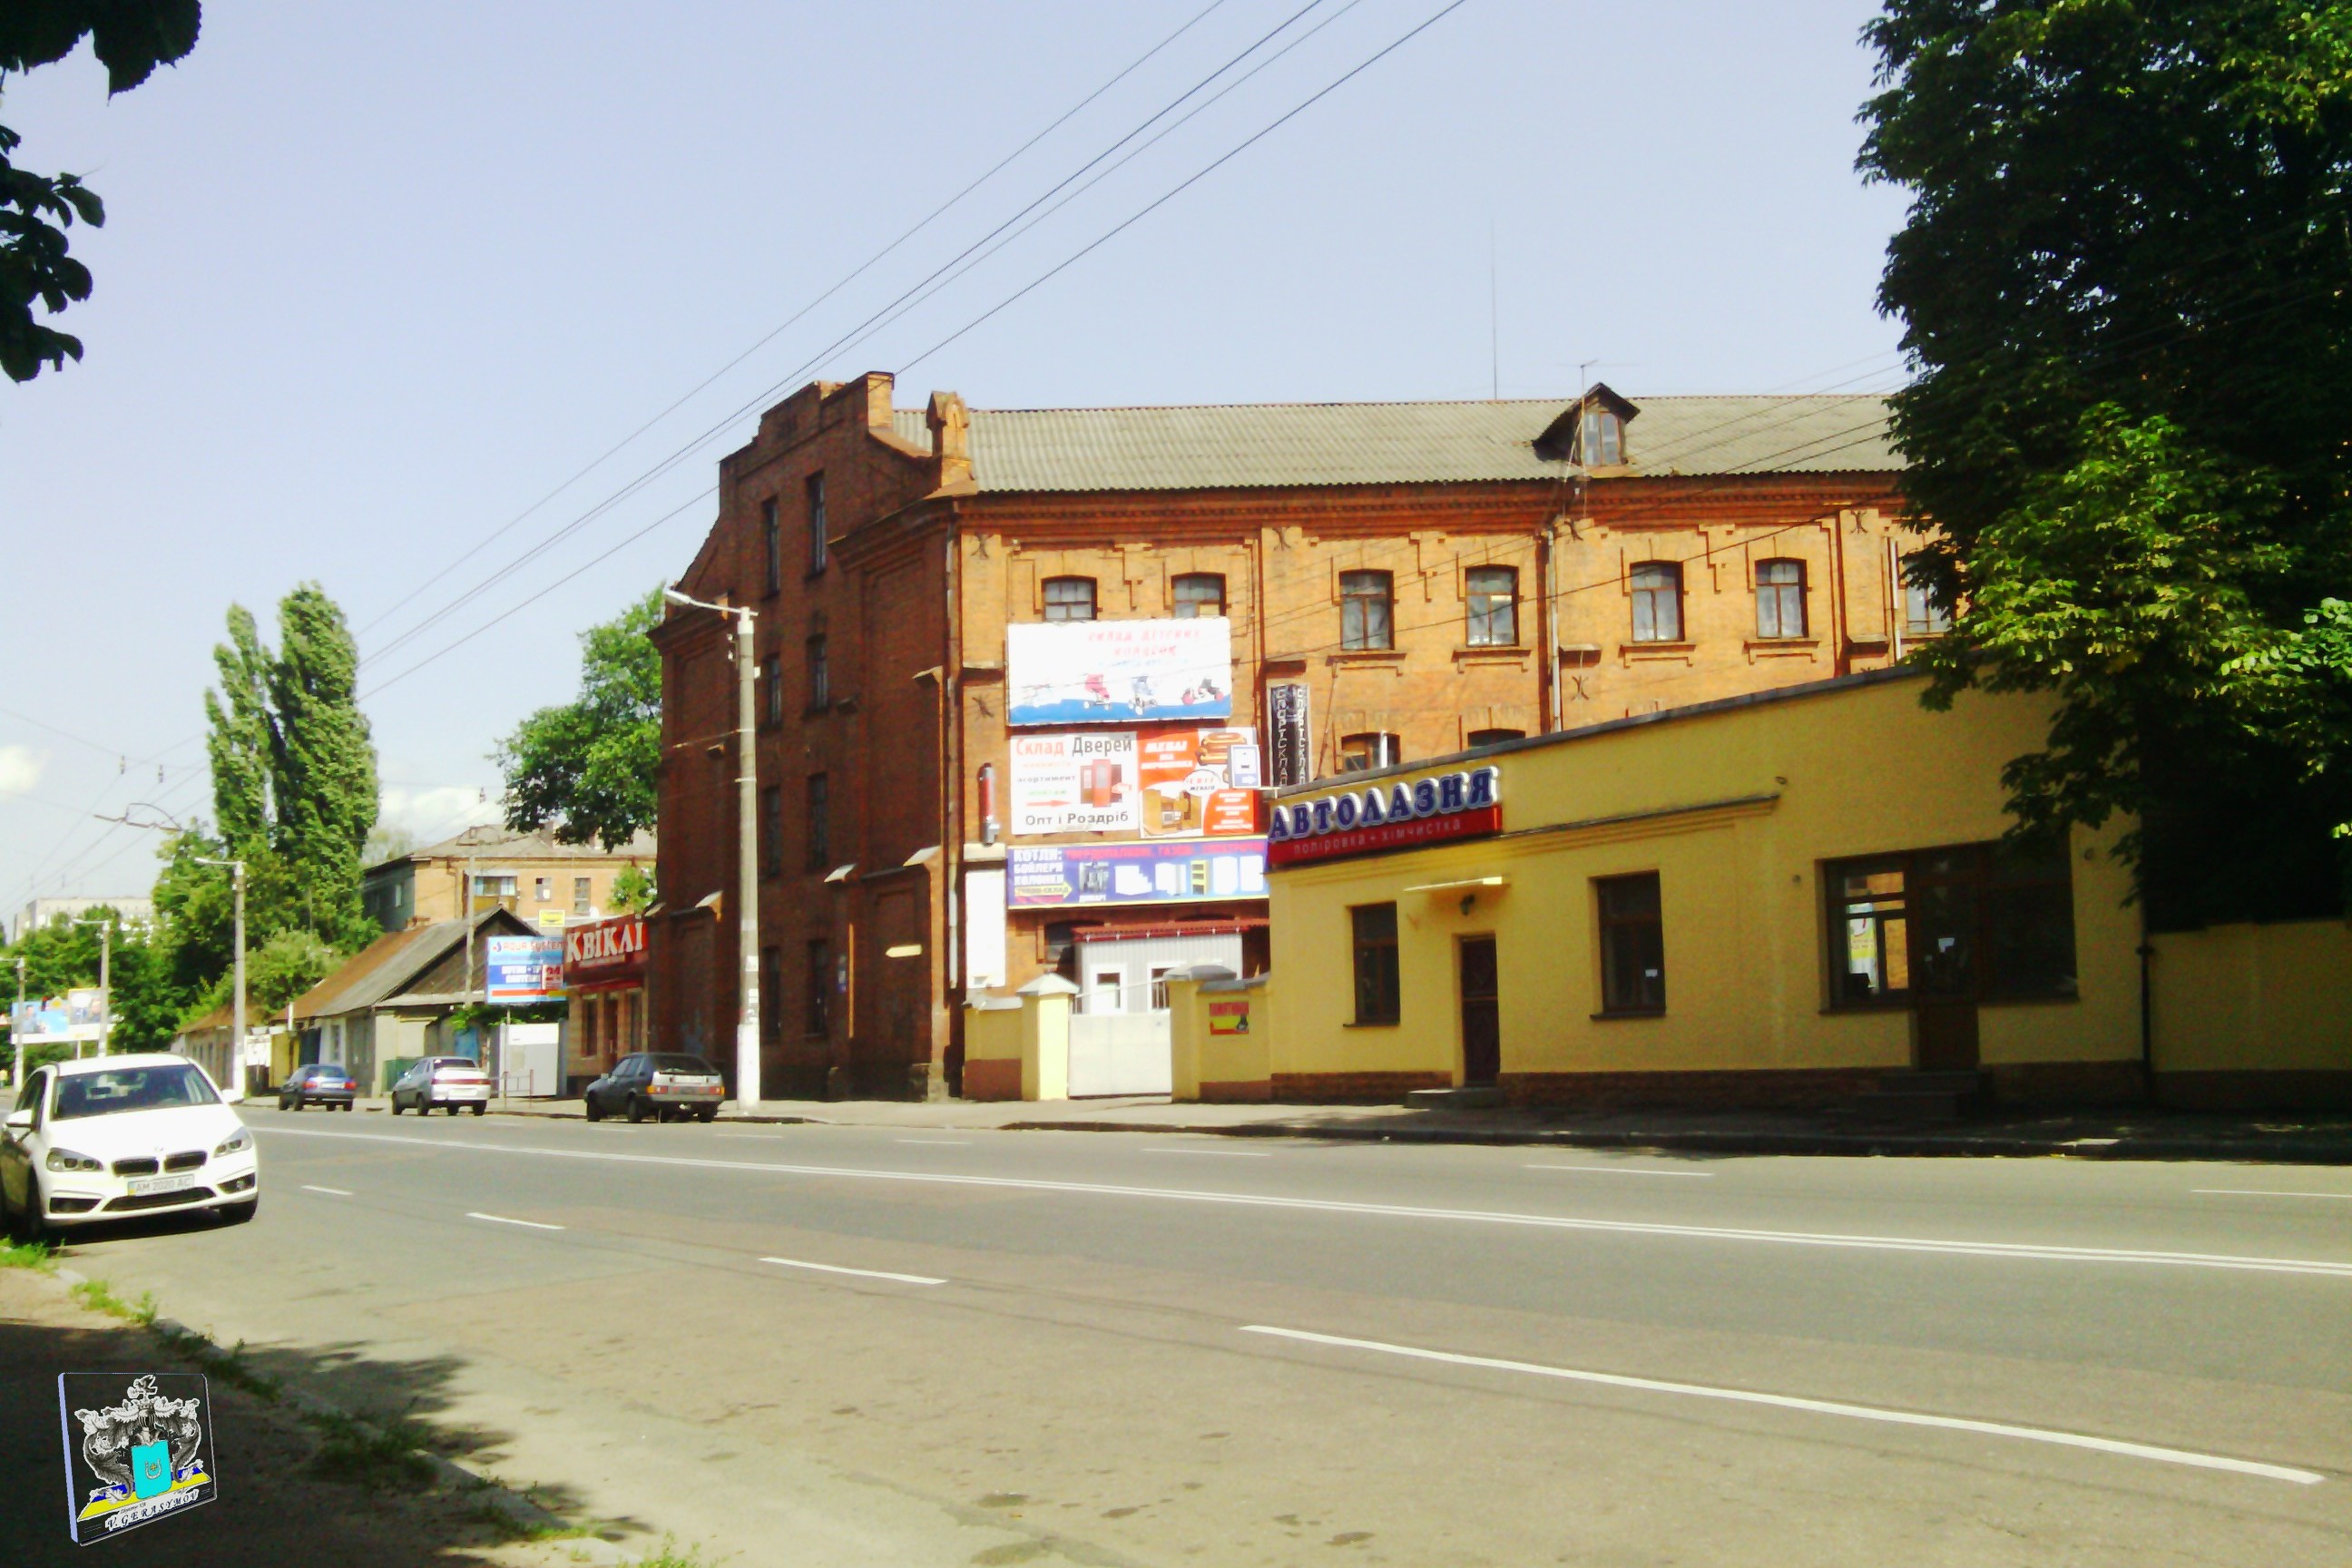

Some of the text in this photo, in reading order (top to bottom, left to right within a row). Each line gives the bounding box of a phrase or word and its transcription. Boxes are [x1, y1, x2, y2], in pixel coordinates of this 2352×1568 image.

[1015, 738, 1064, 757] Склад
[1072, 734, 1132, 757] Дверей
[1025, 815, 1053, 826] Опт
[1067, 811, 1129, 824] Роздріб
[1269, 767, 1499, 842] АВТОЛАЗНЯ
[1294, 834, 1365, 855] поліровка
[1382, 818, 1461, 841] хімчистка
